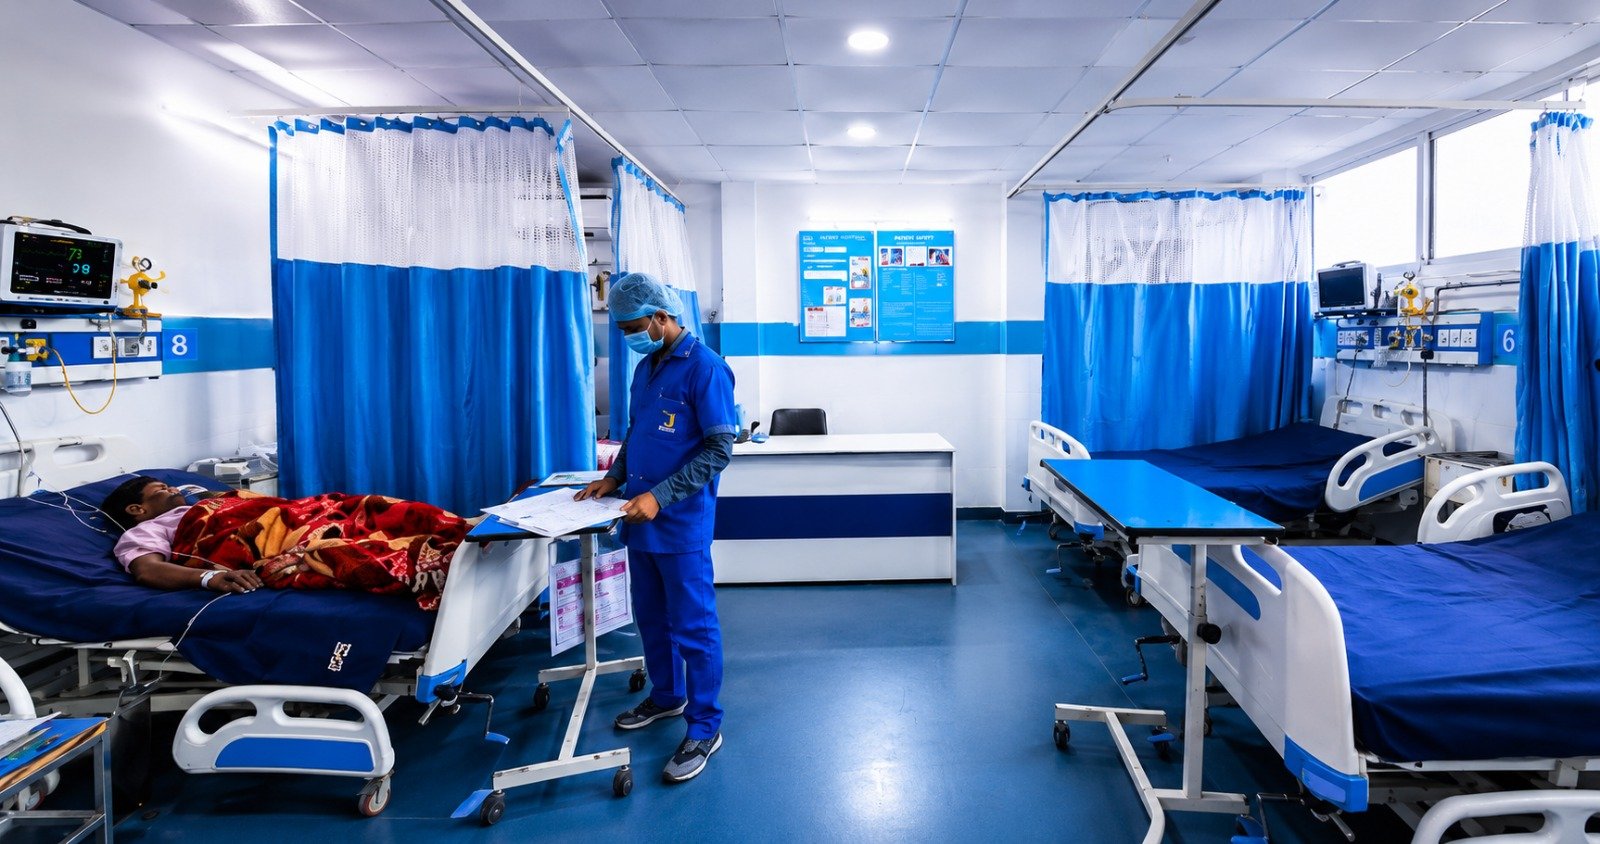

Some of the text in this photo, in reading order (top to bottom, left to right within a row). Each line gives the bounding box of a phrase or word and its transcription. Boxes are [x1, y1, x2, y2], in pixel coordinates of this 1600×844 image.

[69, 248, 82, 261] 73
[171, 334, 188, 356] 8
[1503, 329, 1515, 353] 6
